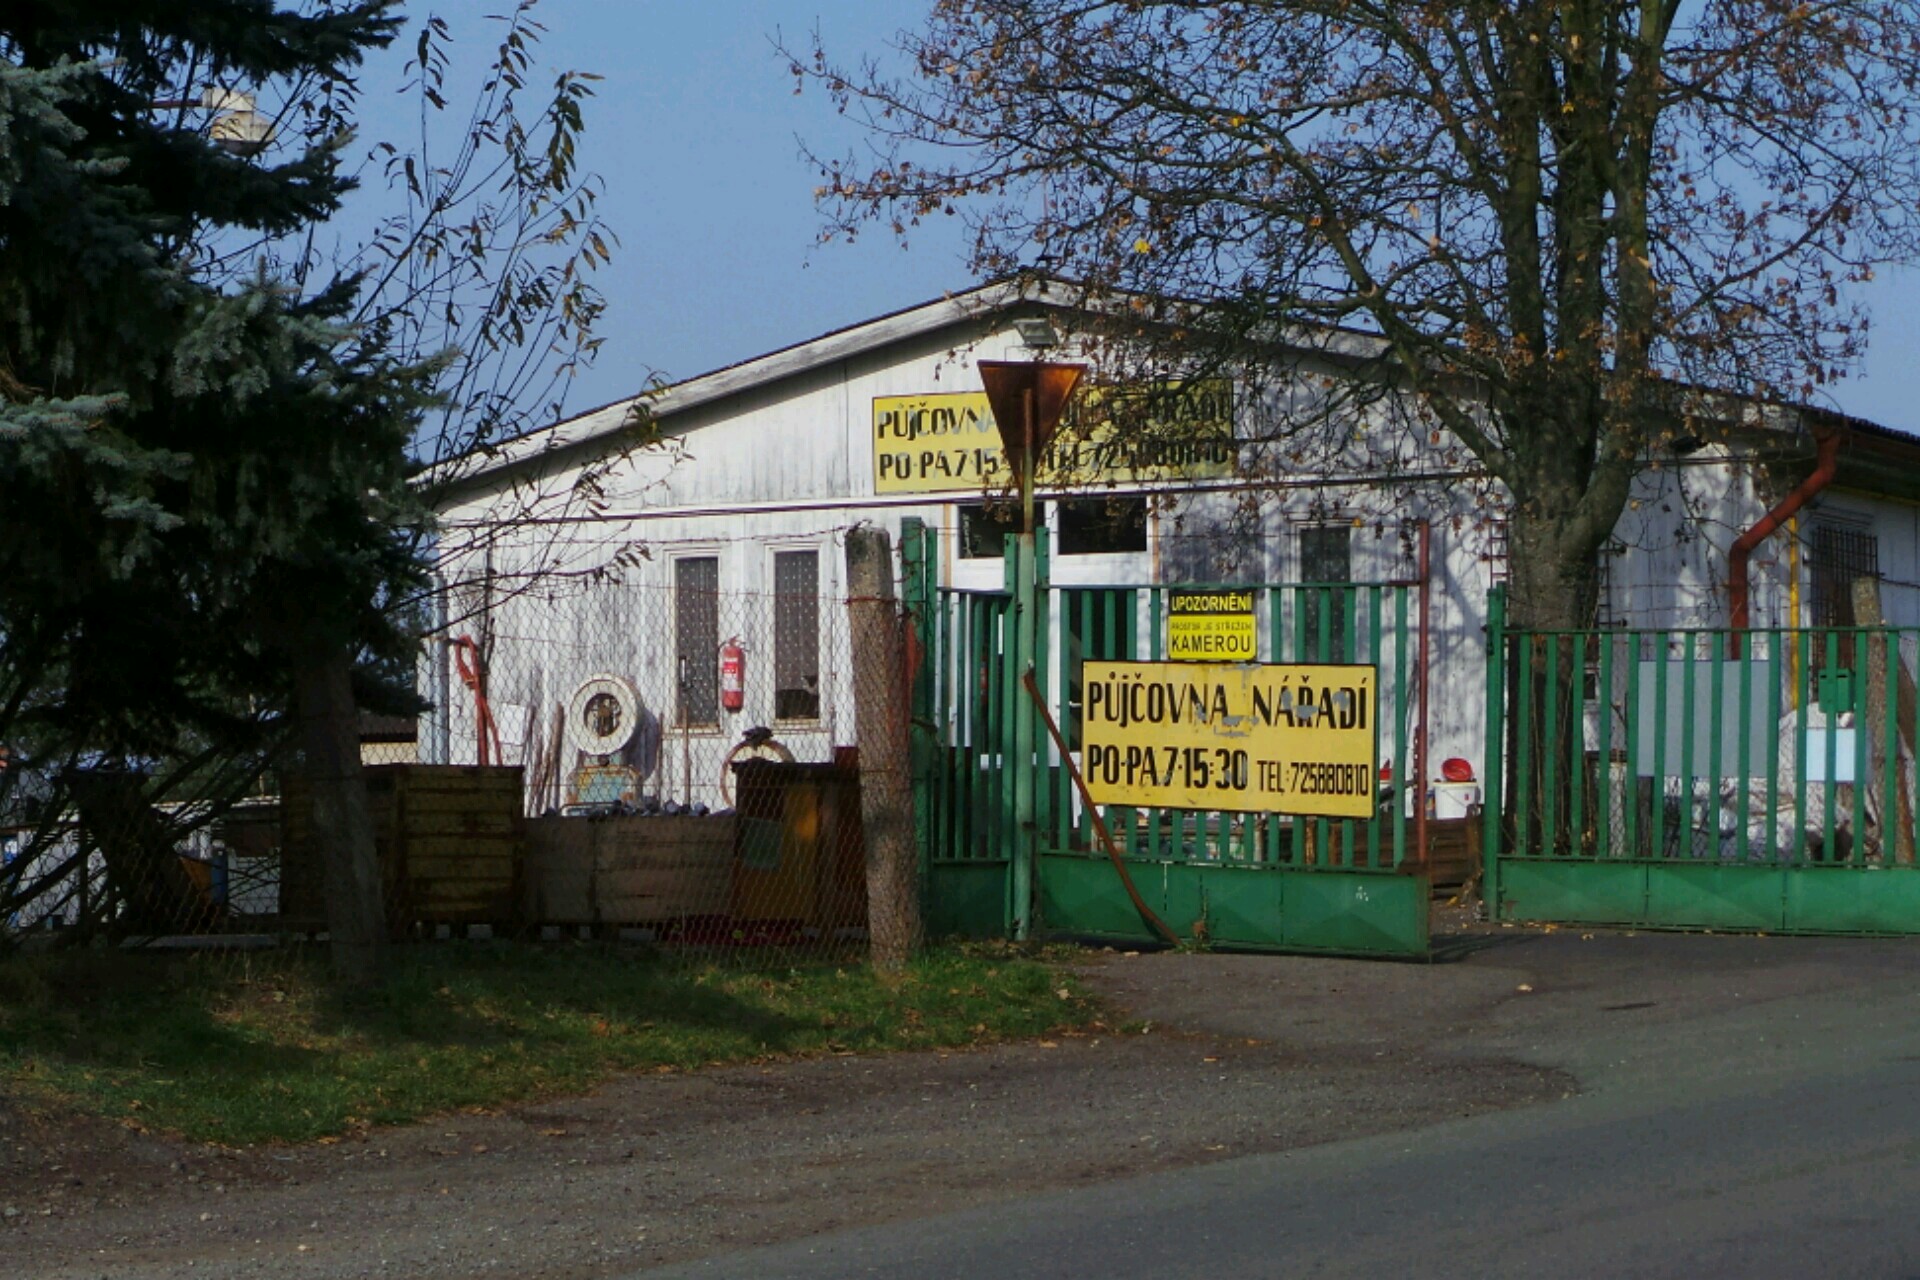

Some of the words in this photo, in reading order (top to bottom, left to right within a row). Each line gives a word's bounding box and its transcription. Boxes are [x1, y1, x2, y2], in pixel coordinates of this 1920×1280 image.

[1172, 592, 1252, 611] UPOZORNĚNÍ
[1172, 634, 1251, 653] KAMEROU
[1086, 671, 1229, 728] PŮJČOVNA
[1252, 674, 1368, 730] NÁŘADÍ
